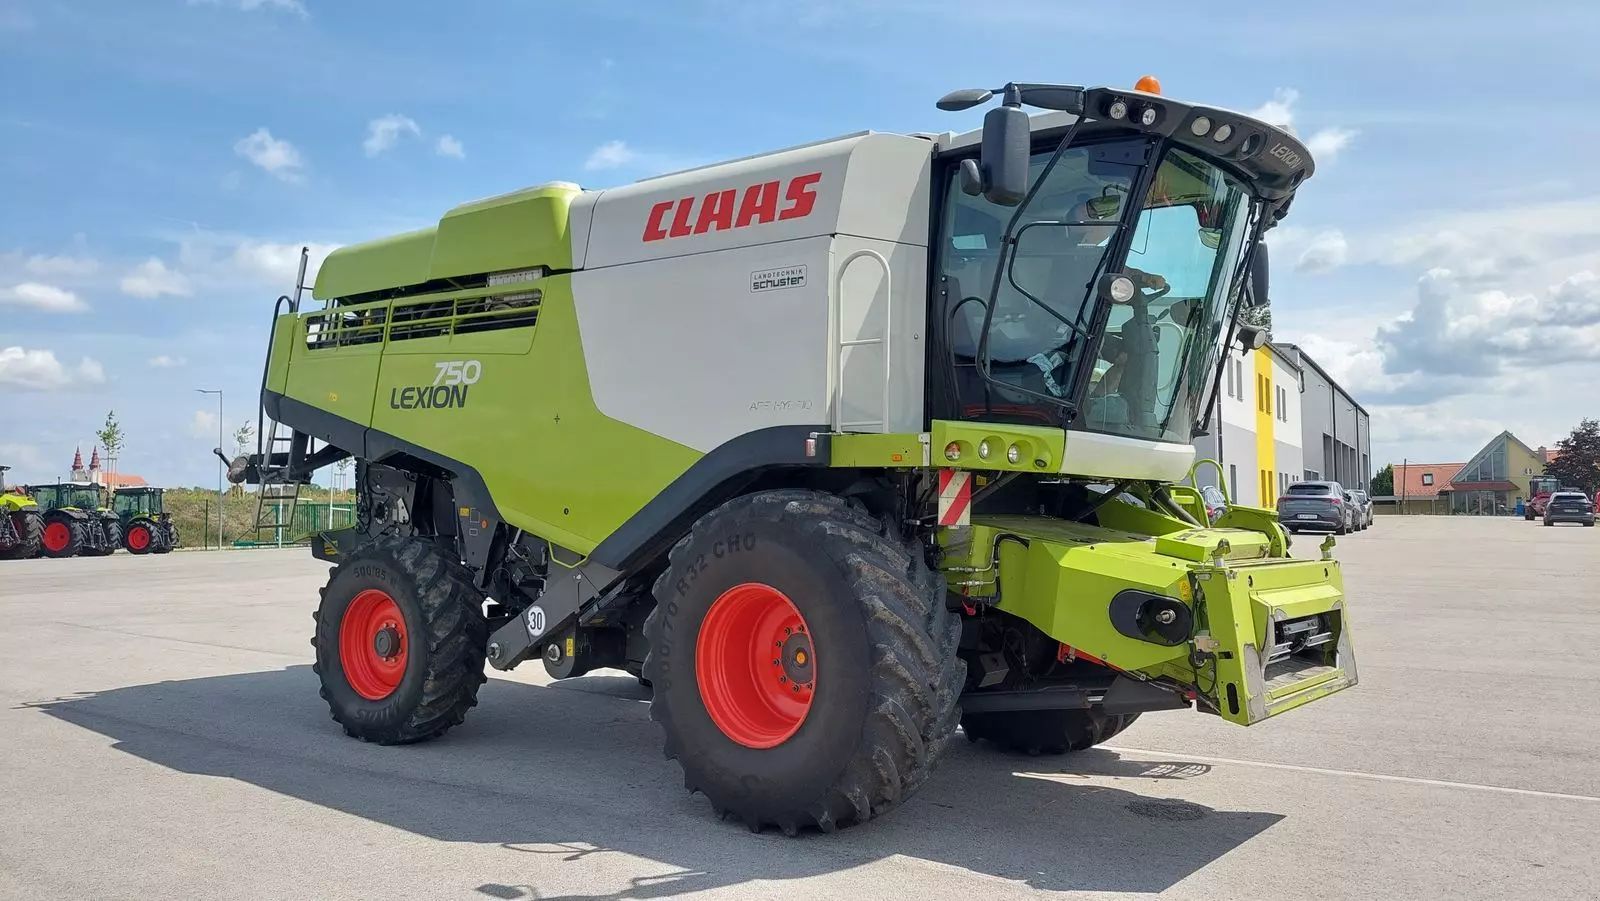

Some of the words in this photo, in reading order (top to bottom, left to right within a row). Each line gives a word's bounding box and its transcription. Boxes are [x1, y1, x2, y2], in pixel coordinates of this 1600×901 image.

[1270, 143, 1304, 168] LEXION
[642, 172, 822, 242] CLAAS
[753, 276, 804, 290] schuster
[754, 269, 803, 280] LANDTECHNIK
[433, 360, 481, 385] 750
[390, 384, 468, 409] LEXION
[530, 611, 542, 630] 30
